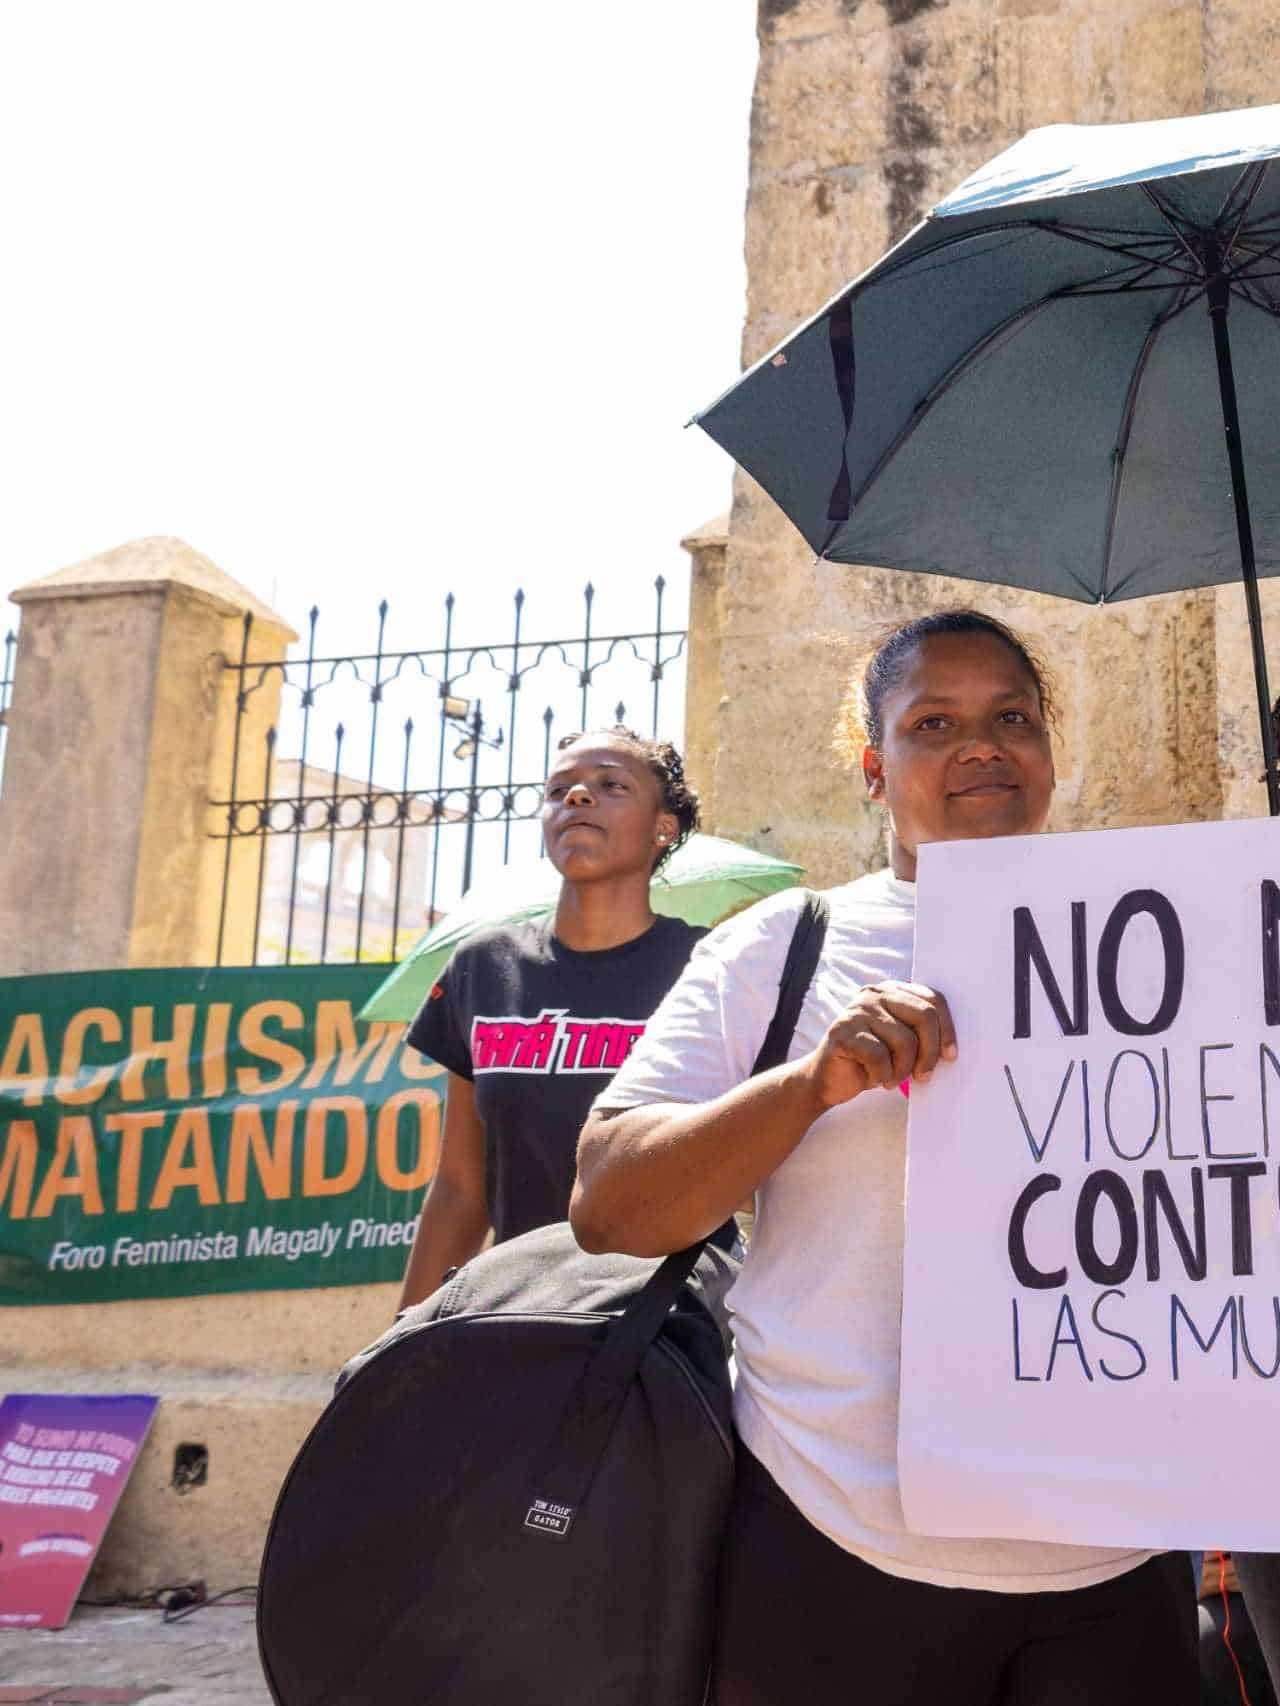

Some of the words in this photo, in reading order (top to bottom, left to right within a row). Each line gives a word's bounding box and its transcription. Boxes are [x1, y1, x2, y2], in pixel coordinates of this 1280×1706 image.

[1013, 889, 1184, 1039] NO
[48, 1242, 105, 1271] Foro
[111, 1231, 239, 1267] Feminista
[246, 1221, 342, 1260] Magaly
[1012, 1289, 1147, 1382] LAS
